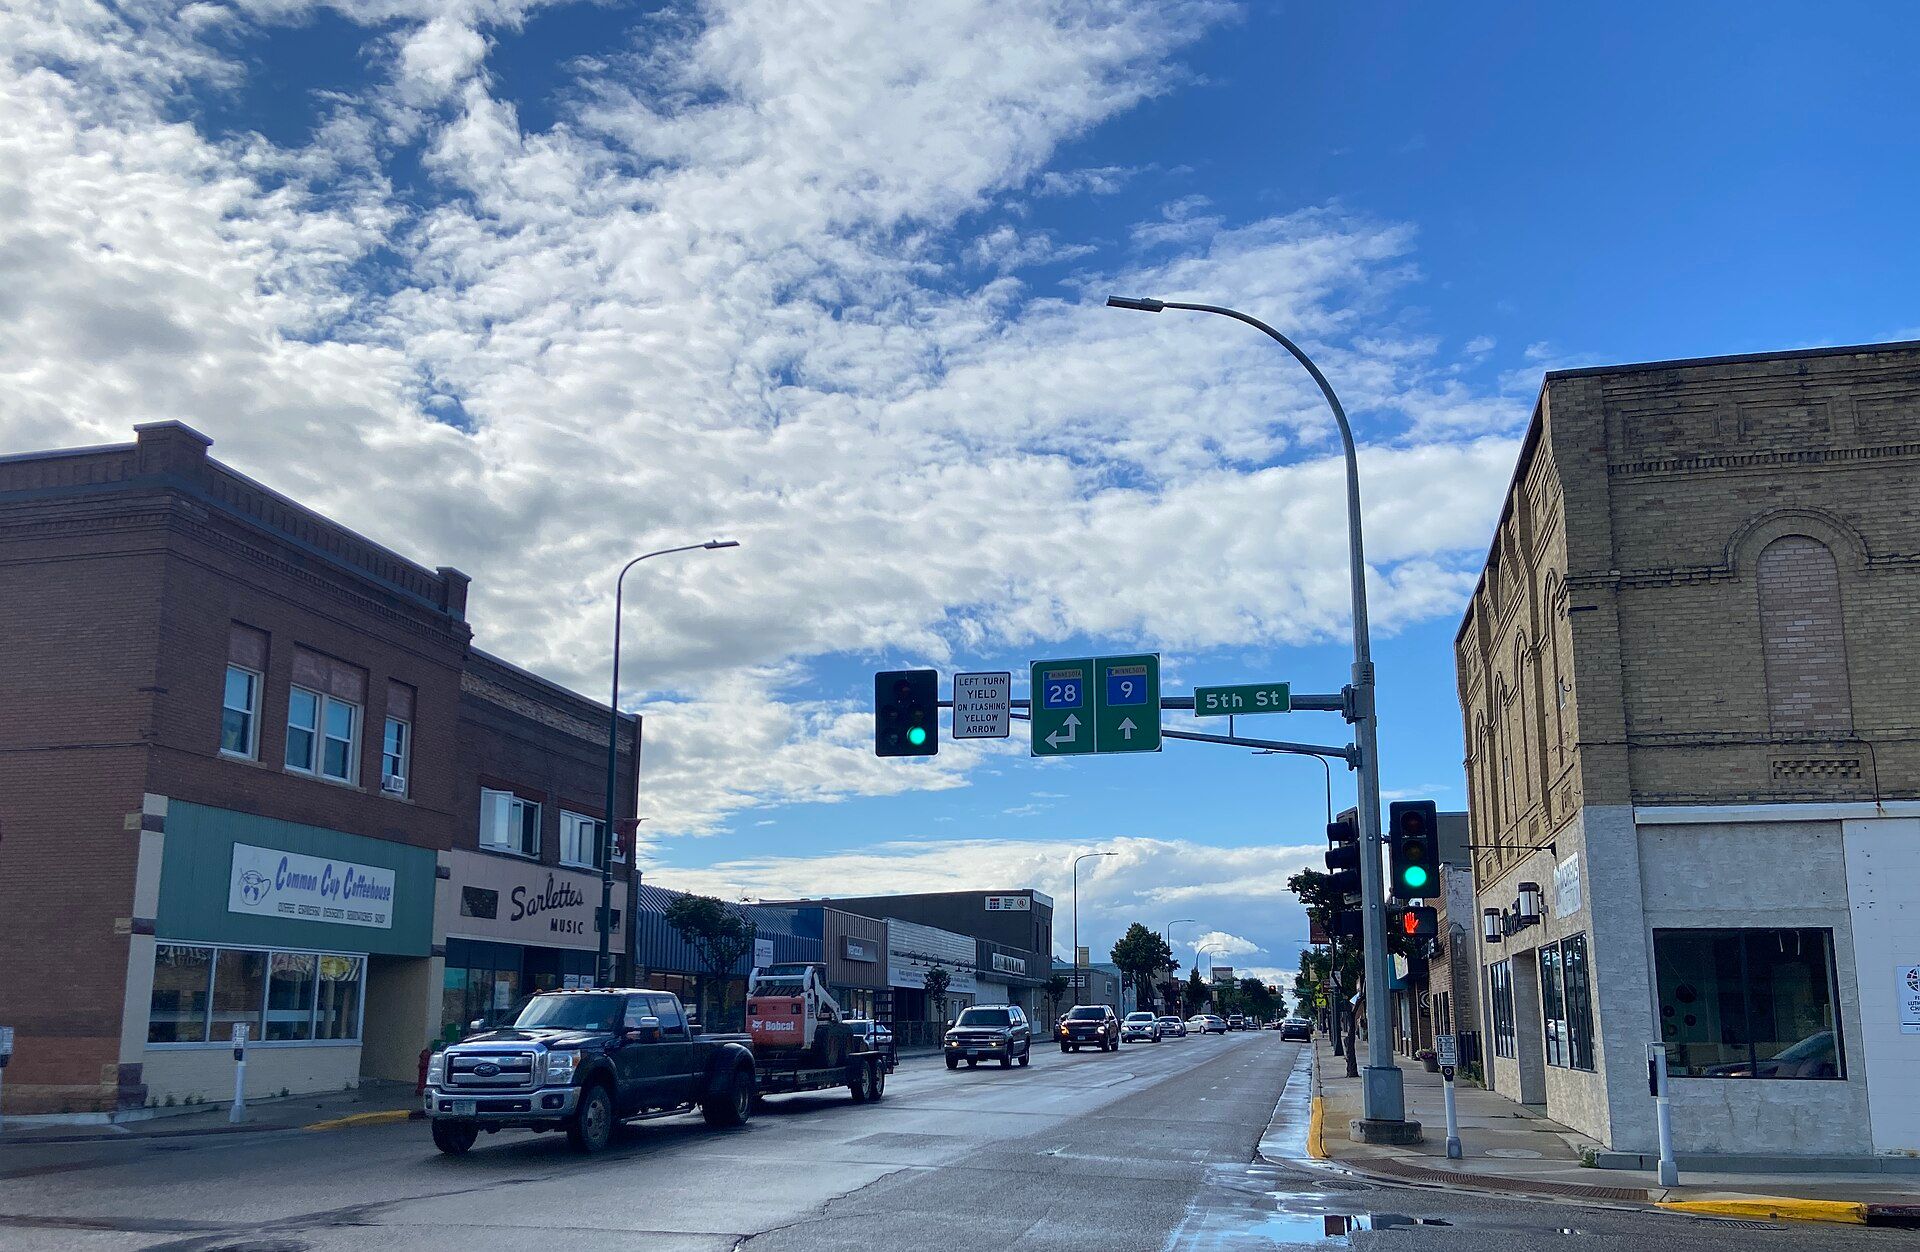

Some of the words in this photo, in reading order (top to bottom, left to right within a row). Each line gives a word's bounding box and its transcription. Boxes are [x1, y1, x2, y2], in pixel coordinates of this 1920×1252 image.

[1051, 670, 1082, 679] MINNESOTA
[1114, 666, 1146, 675] MINNESOTA
[959, 678, 979, 686] LEFT
[983, 677, 1005, 685] TURN
[967, 689, 997, 699] YIELD
[1049, 684, 1076, 703] 28
[1120, 681, 1133, 698] 9
[1206, 692, 1243, 709] 5th
[1255, 690, 1279, 706] St
[957, 703, 968, 711] ON
[971, 702, 1006, 711] FLASHING
[964, 714, 999, 722] YELLOW
[966, 725, 996, 733] ARROW
[275, 856, 318, 891] Common
[320, 863, 341, 901] Cup
[343, 866, 391, 901] Coffeehouse
[510, 872, 584, 921] Sarlettes
[550, 918, 584, 935] MUSIC
[765, 1021, 794, 1031] Bobcat
